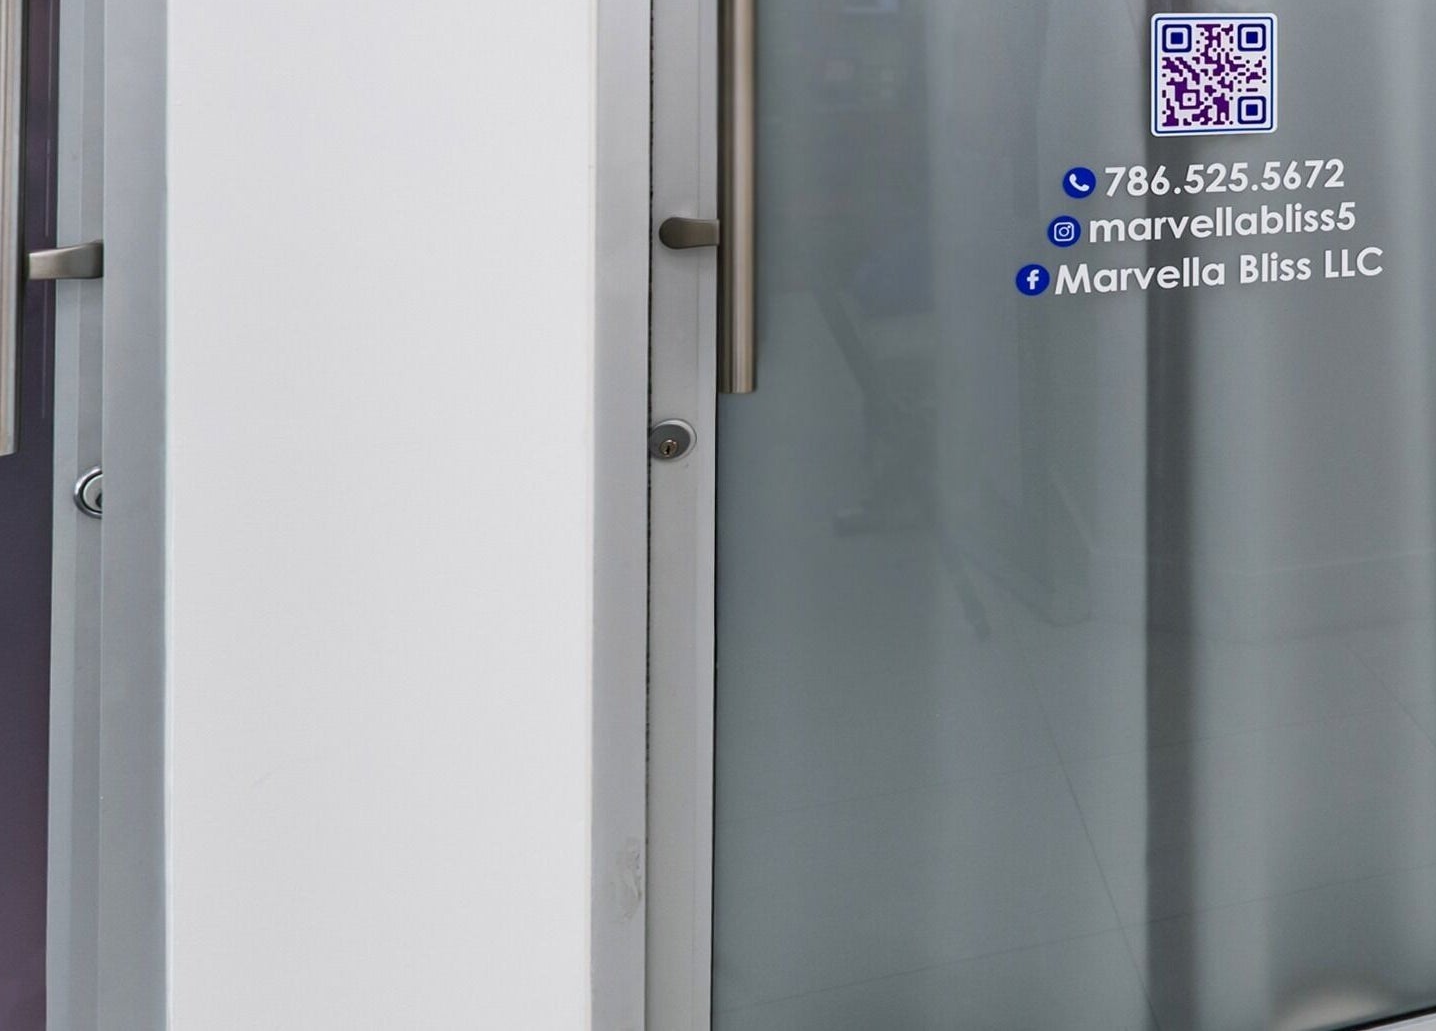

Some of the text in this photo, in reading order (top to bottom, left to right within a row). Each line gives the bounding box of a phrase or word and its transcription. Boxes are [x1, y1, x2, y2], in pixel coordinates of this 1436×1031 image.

[1105, 158, 1345, 197] 786.525.5672
[1088, 201, 1357, 243] marvellabliss5
[1054, 246, 1384, 295] Marvella Bliss LLC
